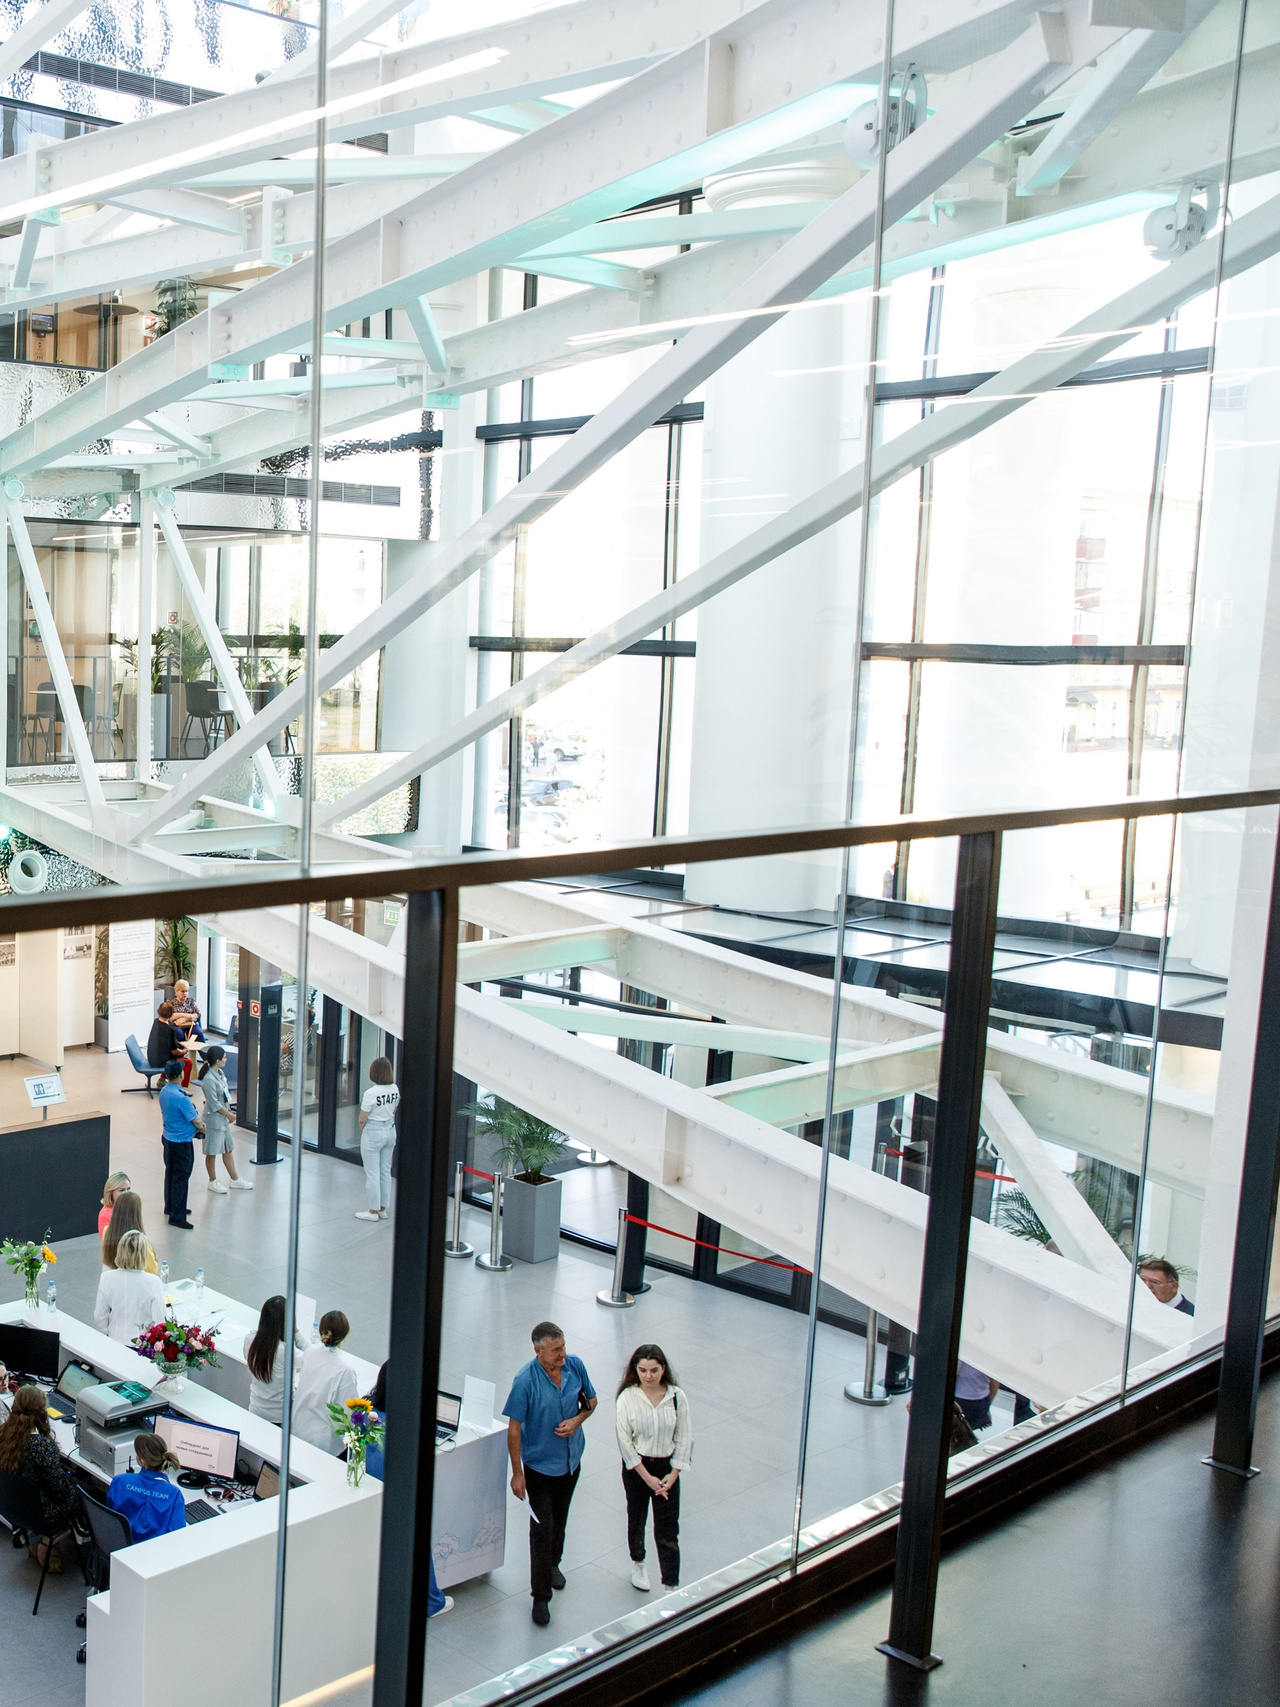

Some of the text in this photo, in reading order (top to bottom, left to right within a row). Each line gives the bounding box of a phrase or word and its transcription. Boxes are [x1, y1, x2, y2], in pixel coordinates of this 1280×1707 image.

[376, 1092, 398, 1107] STAFF
[126, 1483, 169, 1500] CAMPUS TEAM
